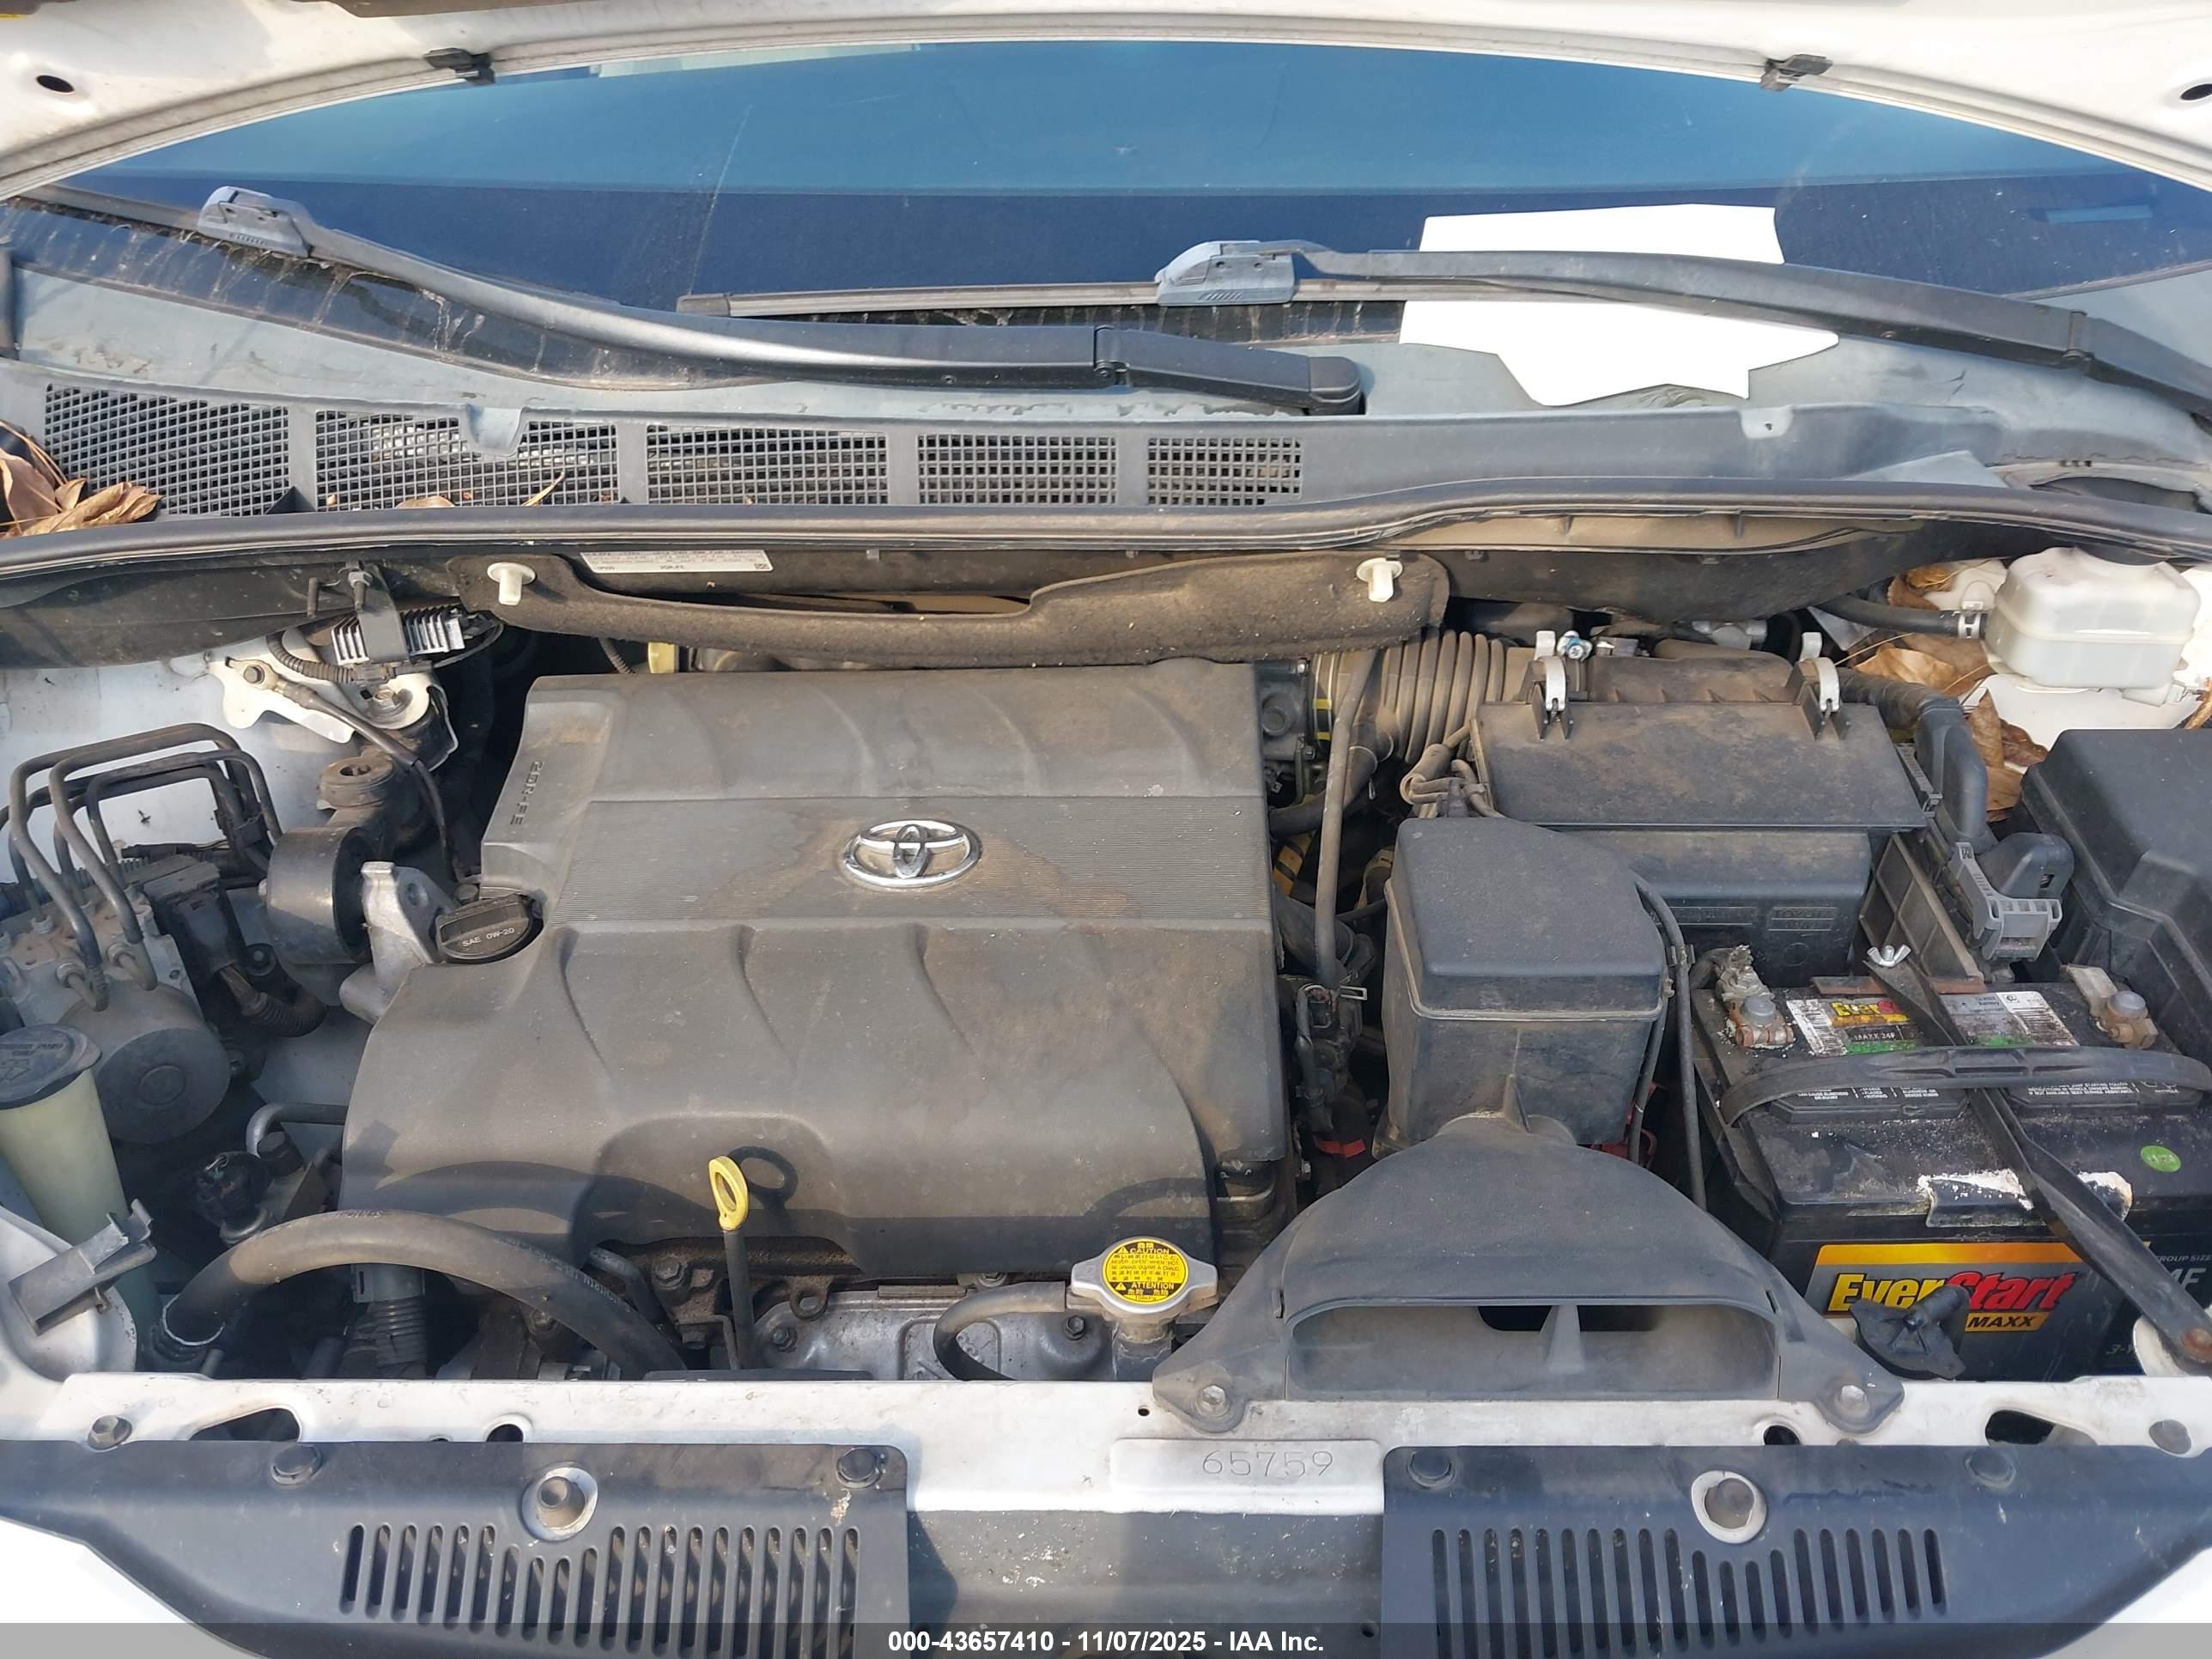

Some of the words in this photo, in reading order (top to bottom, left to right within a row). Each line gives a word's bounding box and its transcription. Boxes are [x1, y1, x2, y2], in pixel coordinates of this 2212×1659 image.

[462, 936, 482, 947] SAE
[485, 927, 515, 939] 0W-20
[1131, 1281, 1175, 1290] ATTENTION
[1827, 1271, 2076, 1312] EverStart
[1967, 1316, 2036, 1328] MAXX
[1202, 1449, 1334, 1477] 65759
